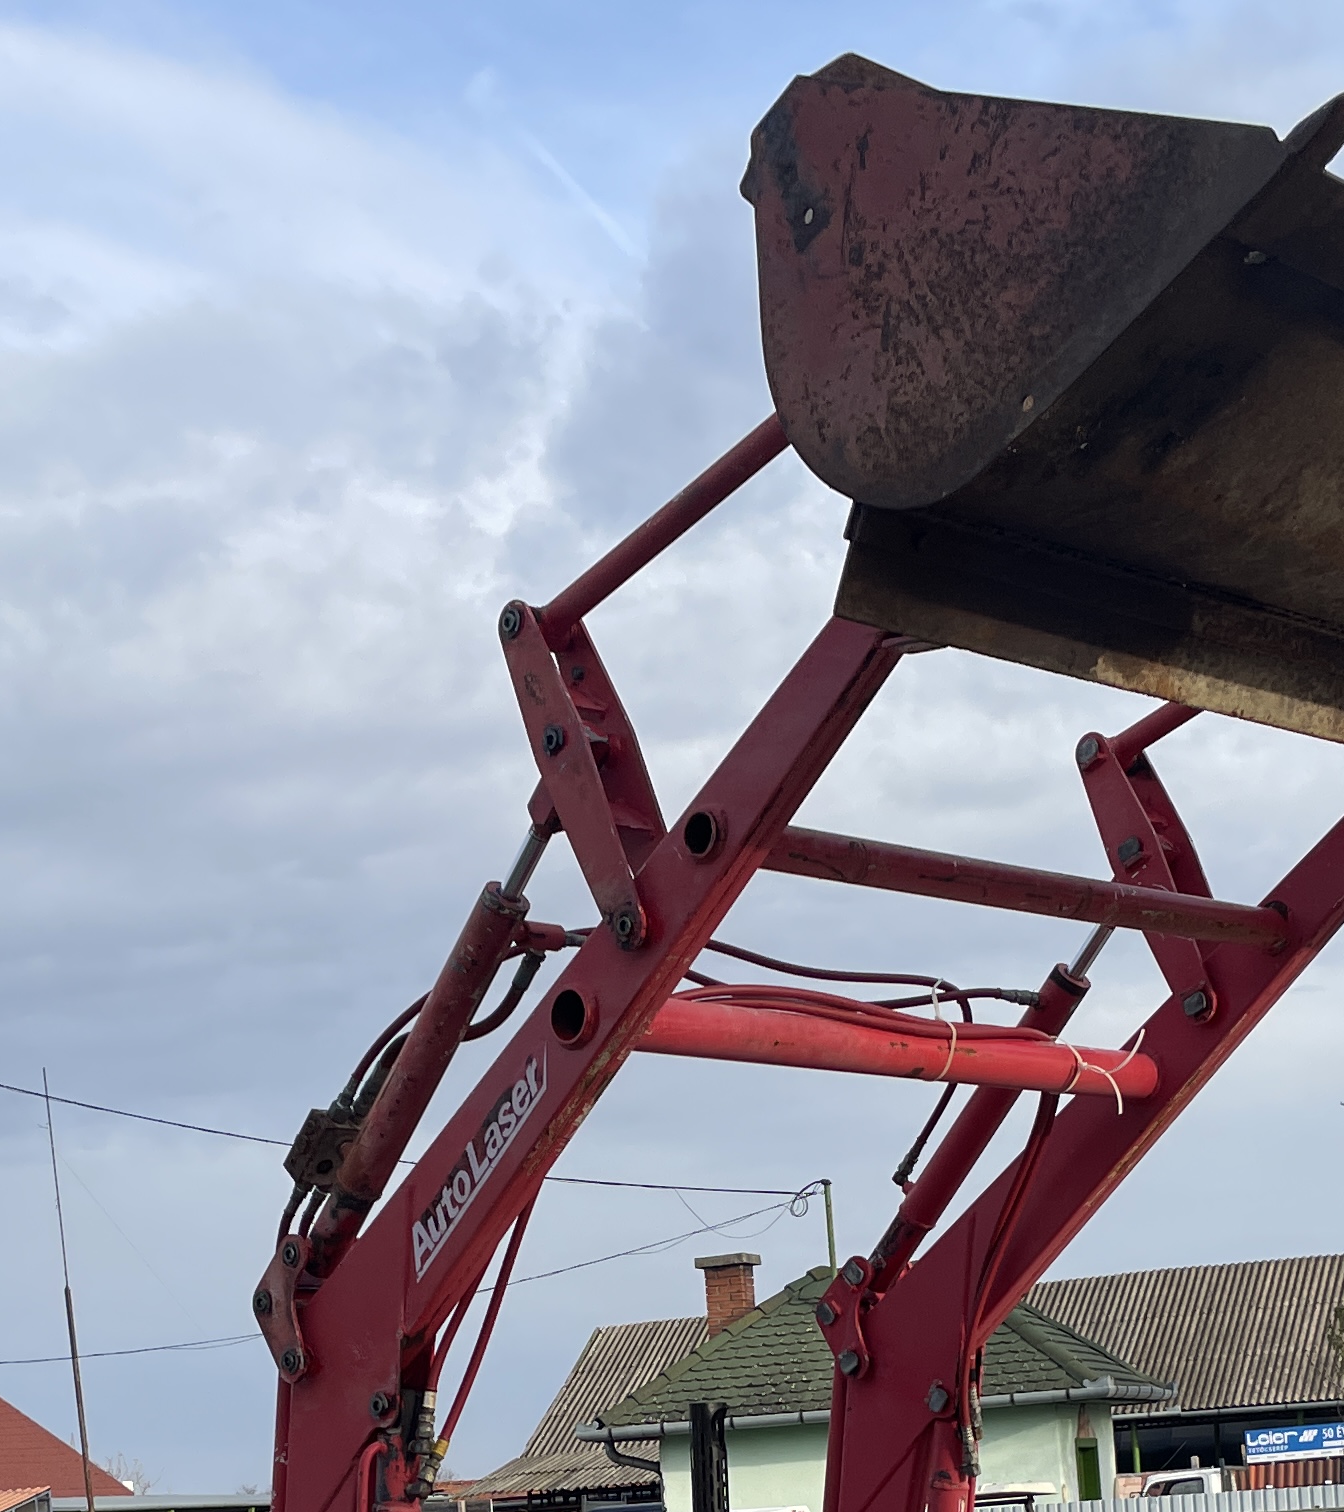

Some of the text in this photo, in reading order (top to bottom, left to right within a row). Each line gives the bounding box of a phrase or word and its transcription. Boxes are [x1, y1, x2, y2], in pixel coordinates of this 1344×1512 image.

[411, 1057, 539, 1272] AutoLaser
[1246, 1430, 1298, 1447] Leier
[1322, 1428, 1334, 1440] 50
